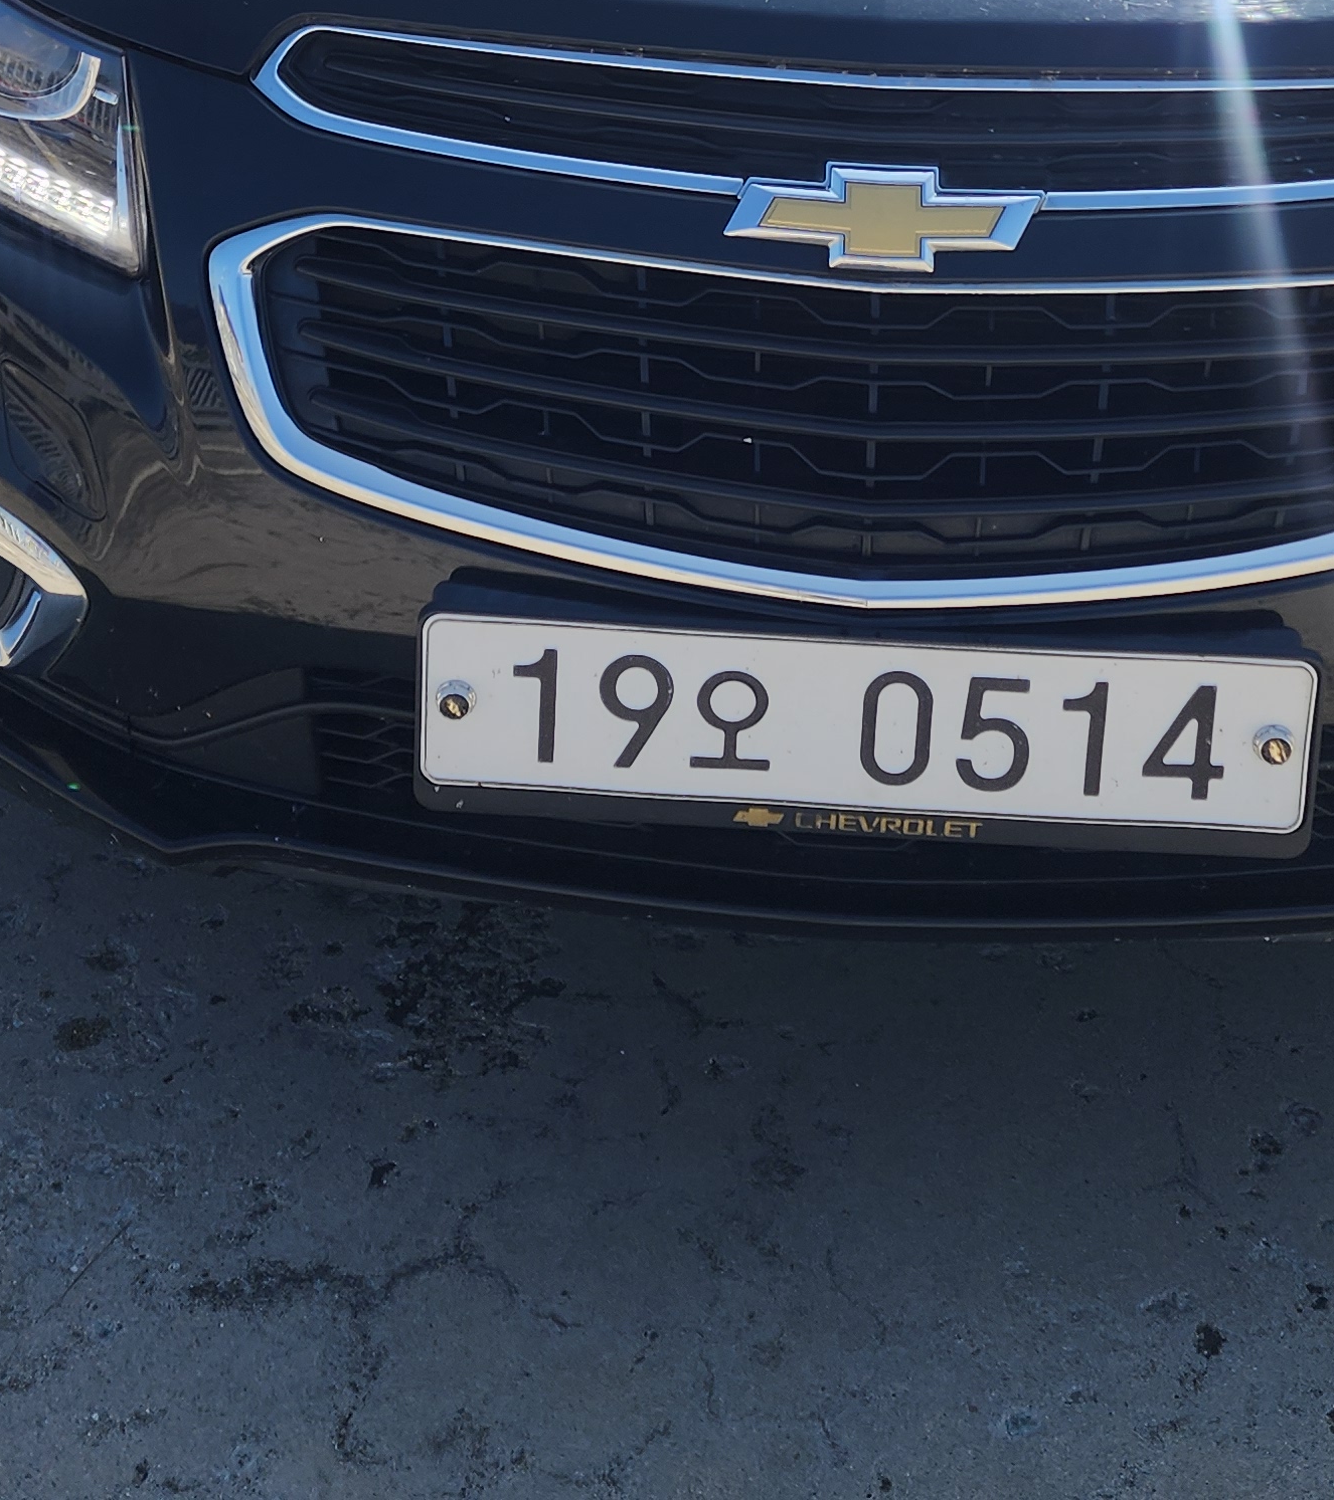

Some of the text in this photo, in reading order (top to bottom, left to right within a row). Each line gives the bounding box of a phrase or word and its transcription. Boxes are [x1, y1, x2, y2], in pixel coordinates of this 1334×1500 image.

[510, 647, 1226, 802] 19오 0514
[795, 811, 984, 839] CHEVROLET
